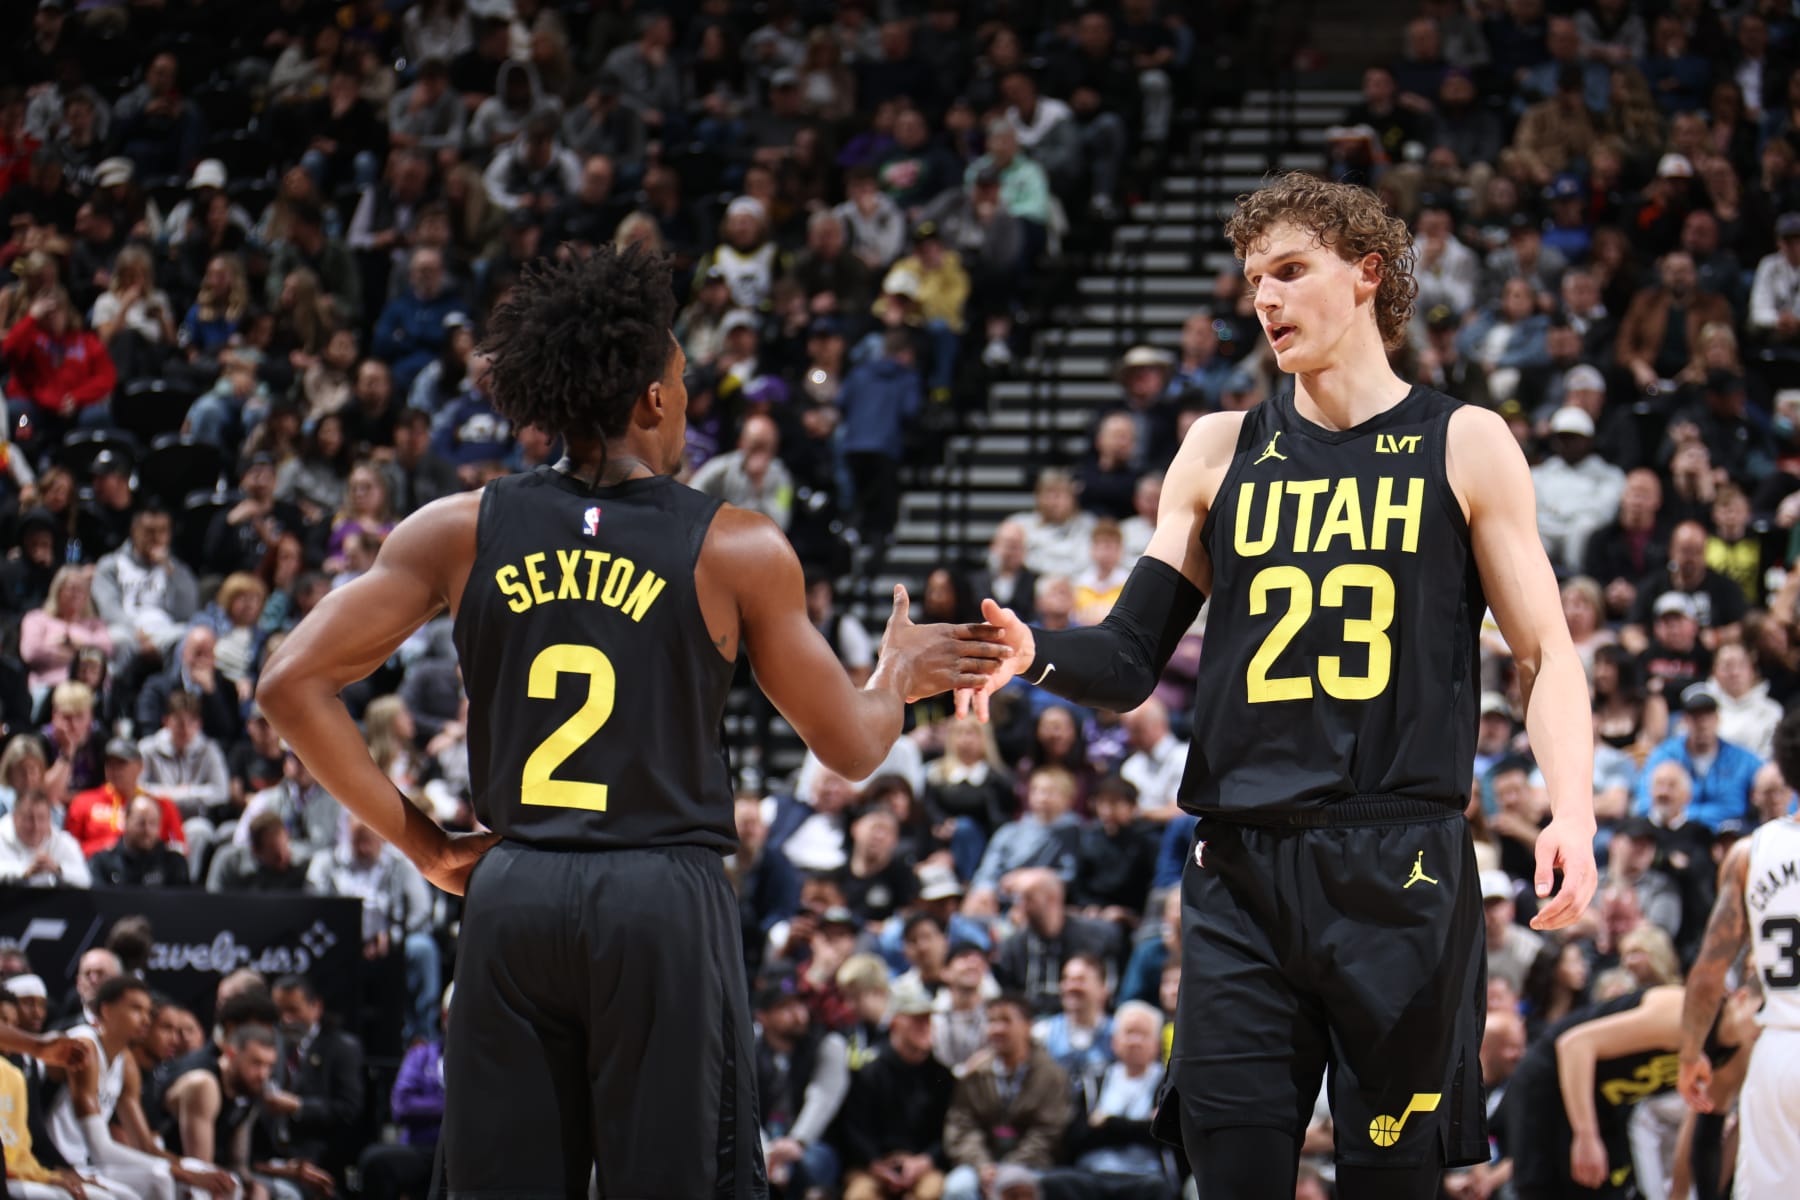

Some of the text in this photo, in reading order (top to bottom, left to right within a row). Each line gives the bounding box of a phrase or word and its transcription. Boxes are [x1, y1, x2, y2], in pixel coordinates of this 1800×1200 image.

[1376, 434, 1422, 453] LVT
[1234, 476, 1424, 557] UTAH
[495, 550, 666, 622] SEXTON
[1247, 564, 1395, 703] 23
[521, 643, 616, 812] 2
